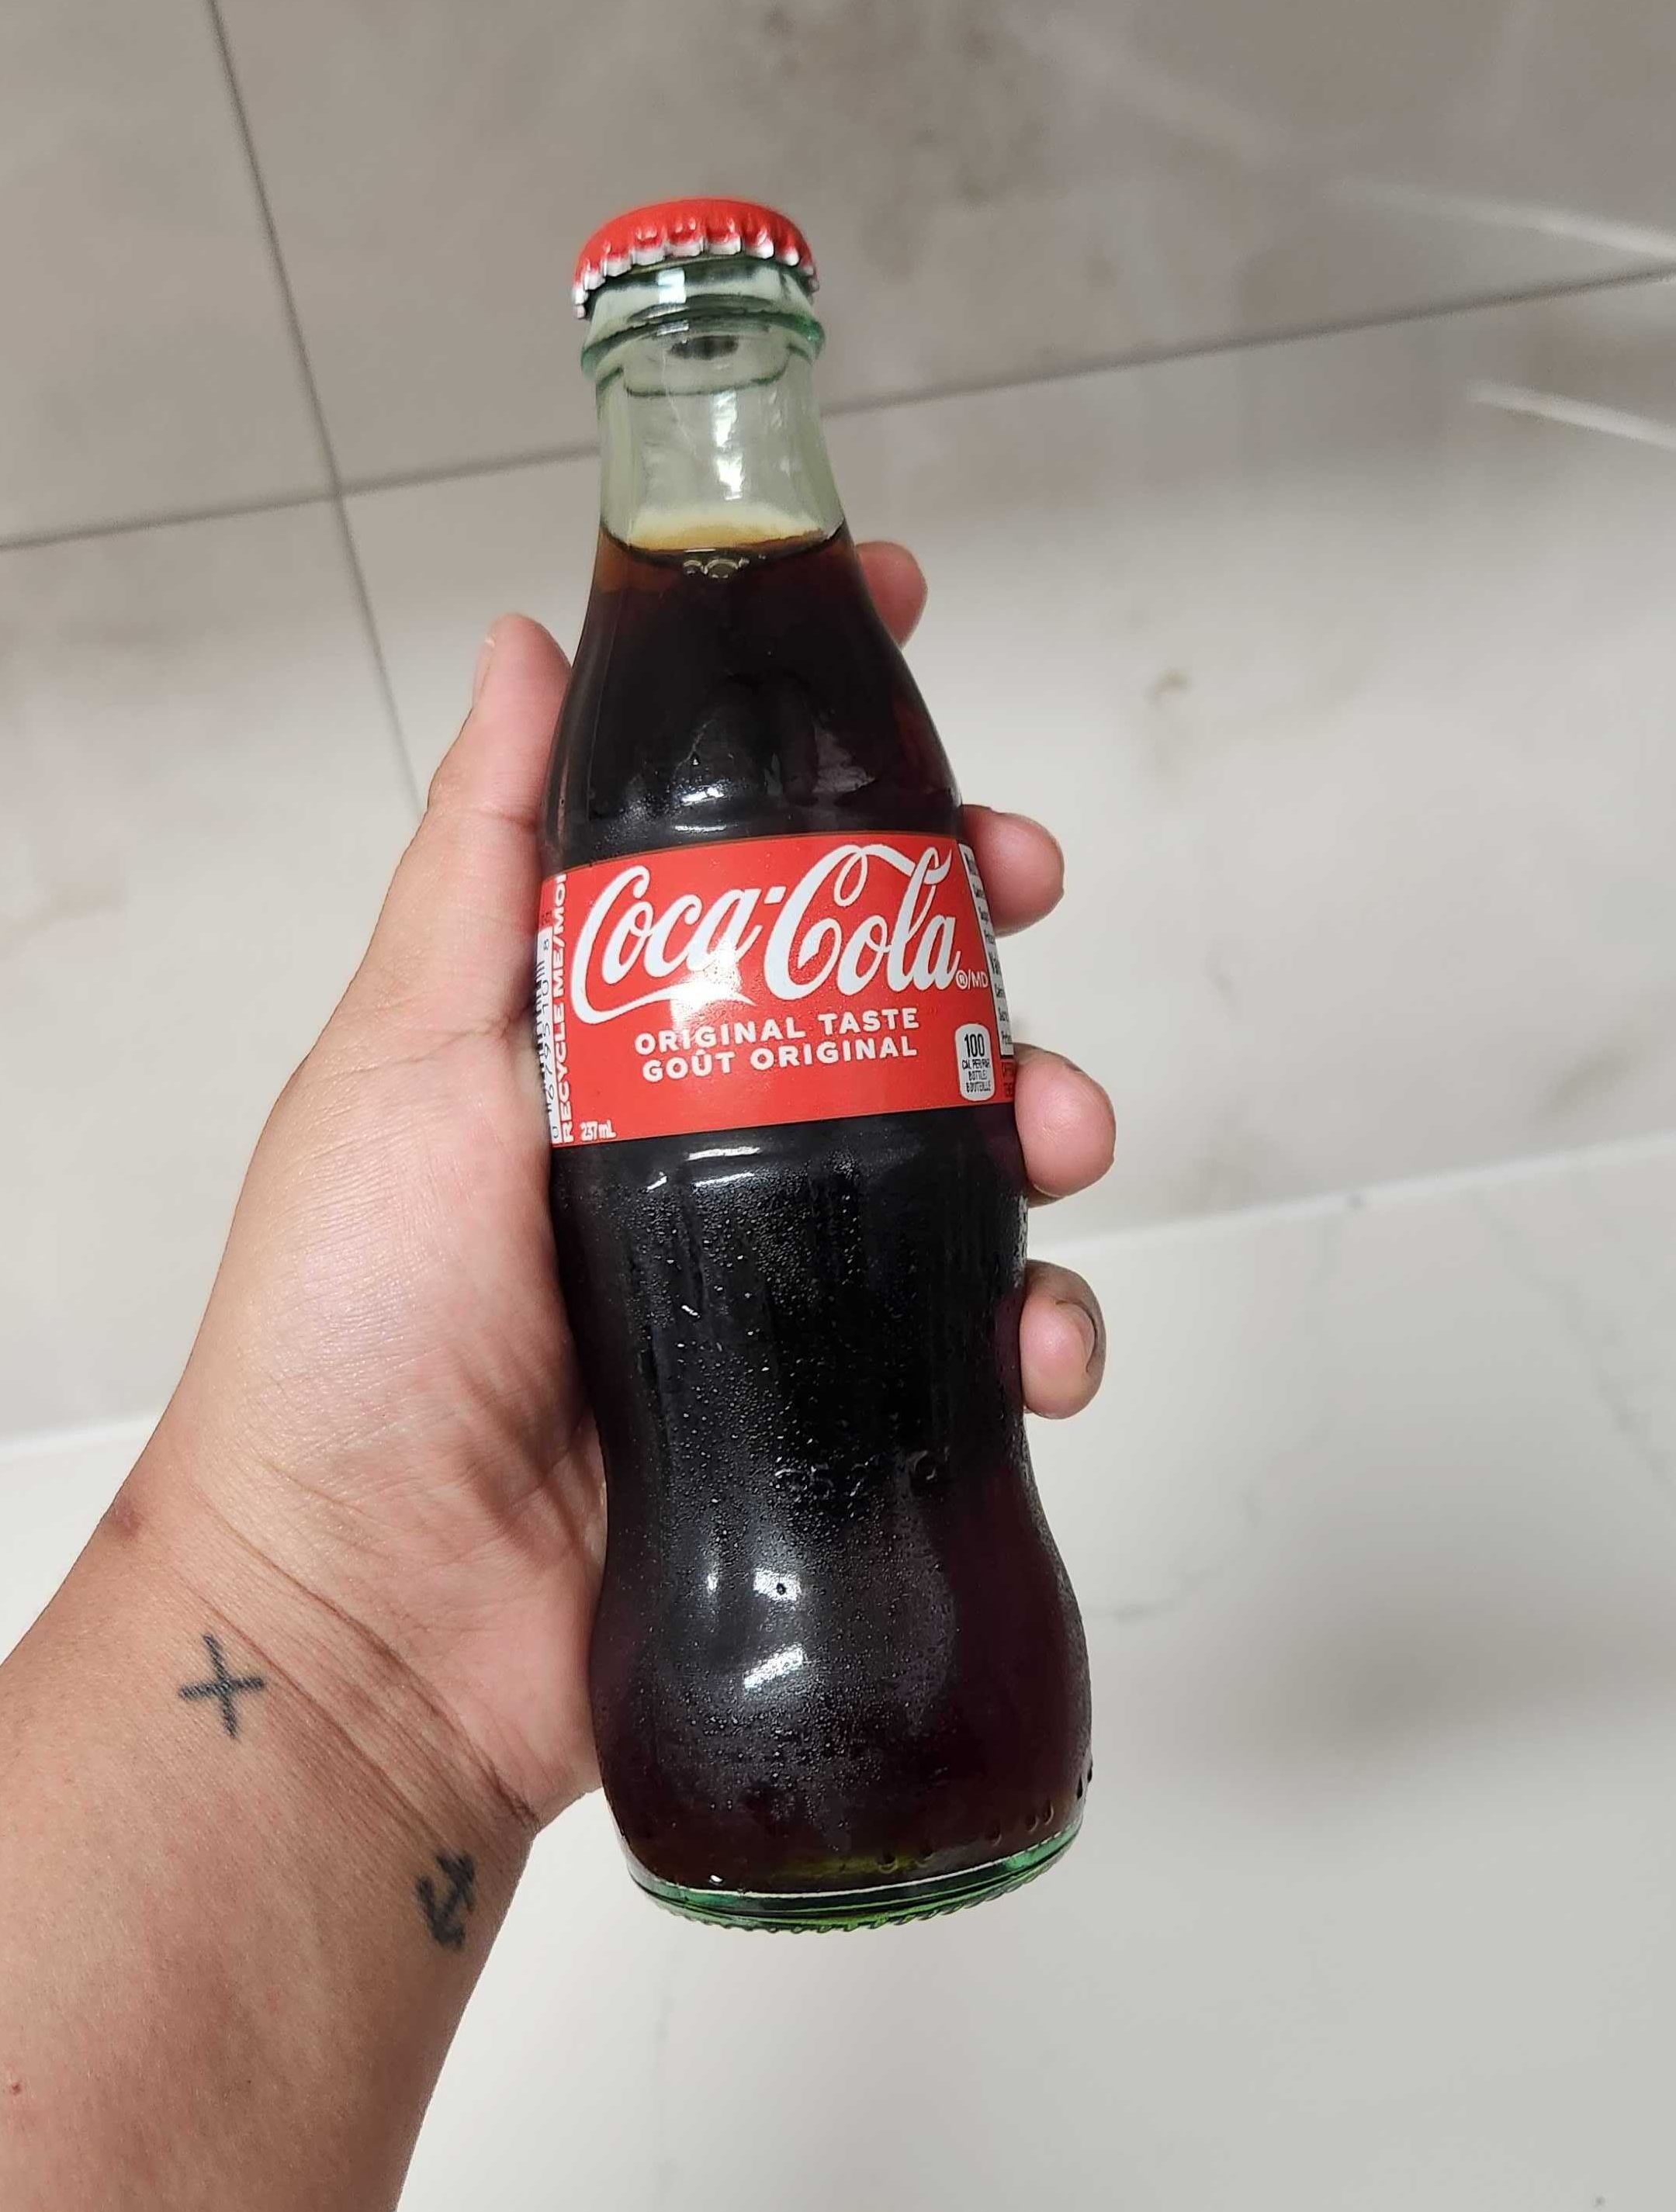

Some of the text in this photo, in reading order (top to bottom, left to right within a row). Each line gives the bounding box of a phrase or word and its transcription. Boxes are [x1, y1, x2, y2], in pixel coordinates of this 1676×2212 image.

[572, 844, 961, 1023] Coca-Cola
[635, 1008, 919, 1055] ORIGINAL TASTE
[964, 1033, 985, 1058] 100
[552, 1002, 574, 1144] RECYCLE
[642, 1037, 917, 1082] GOÛT ORIGINAL
